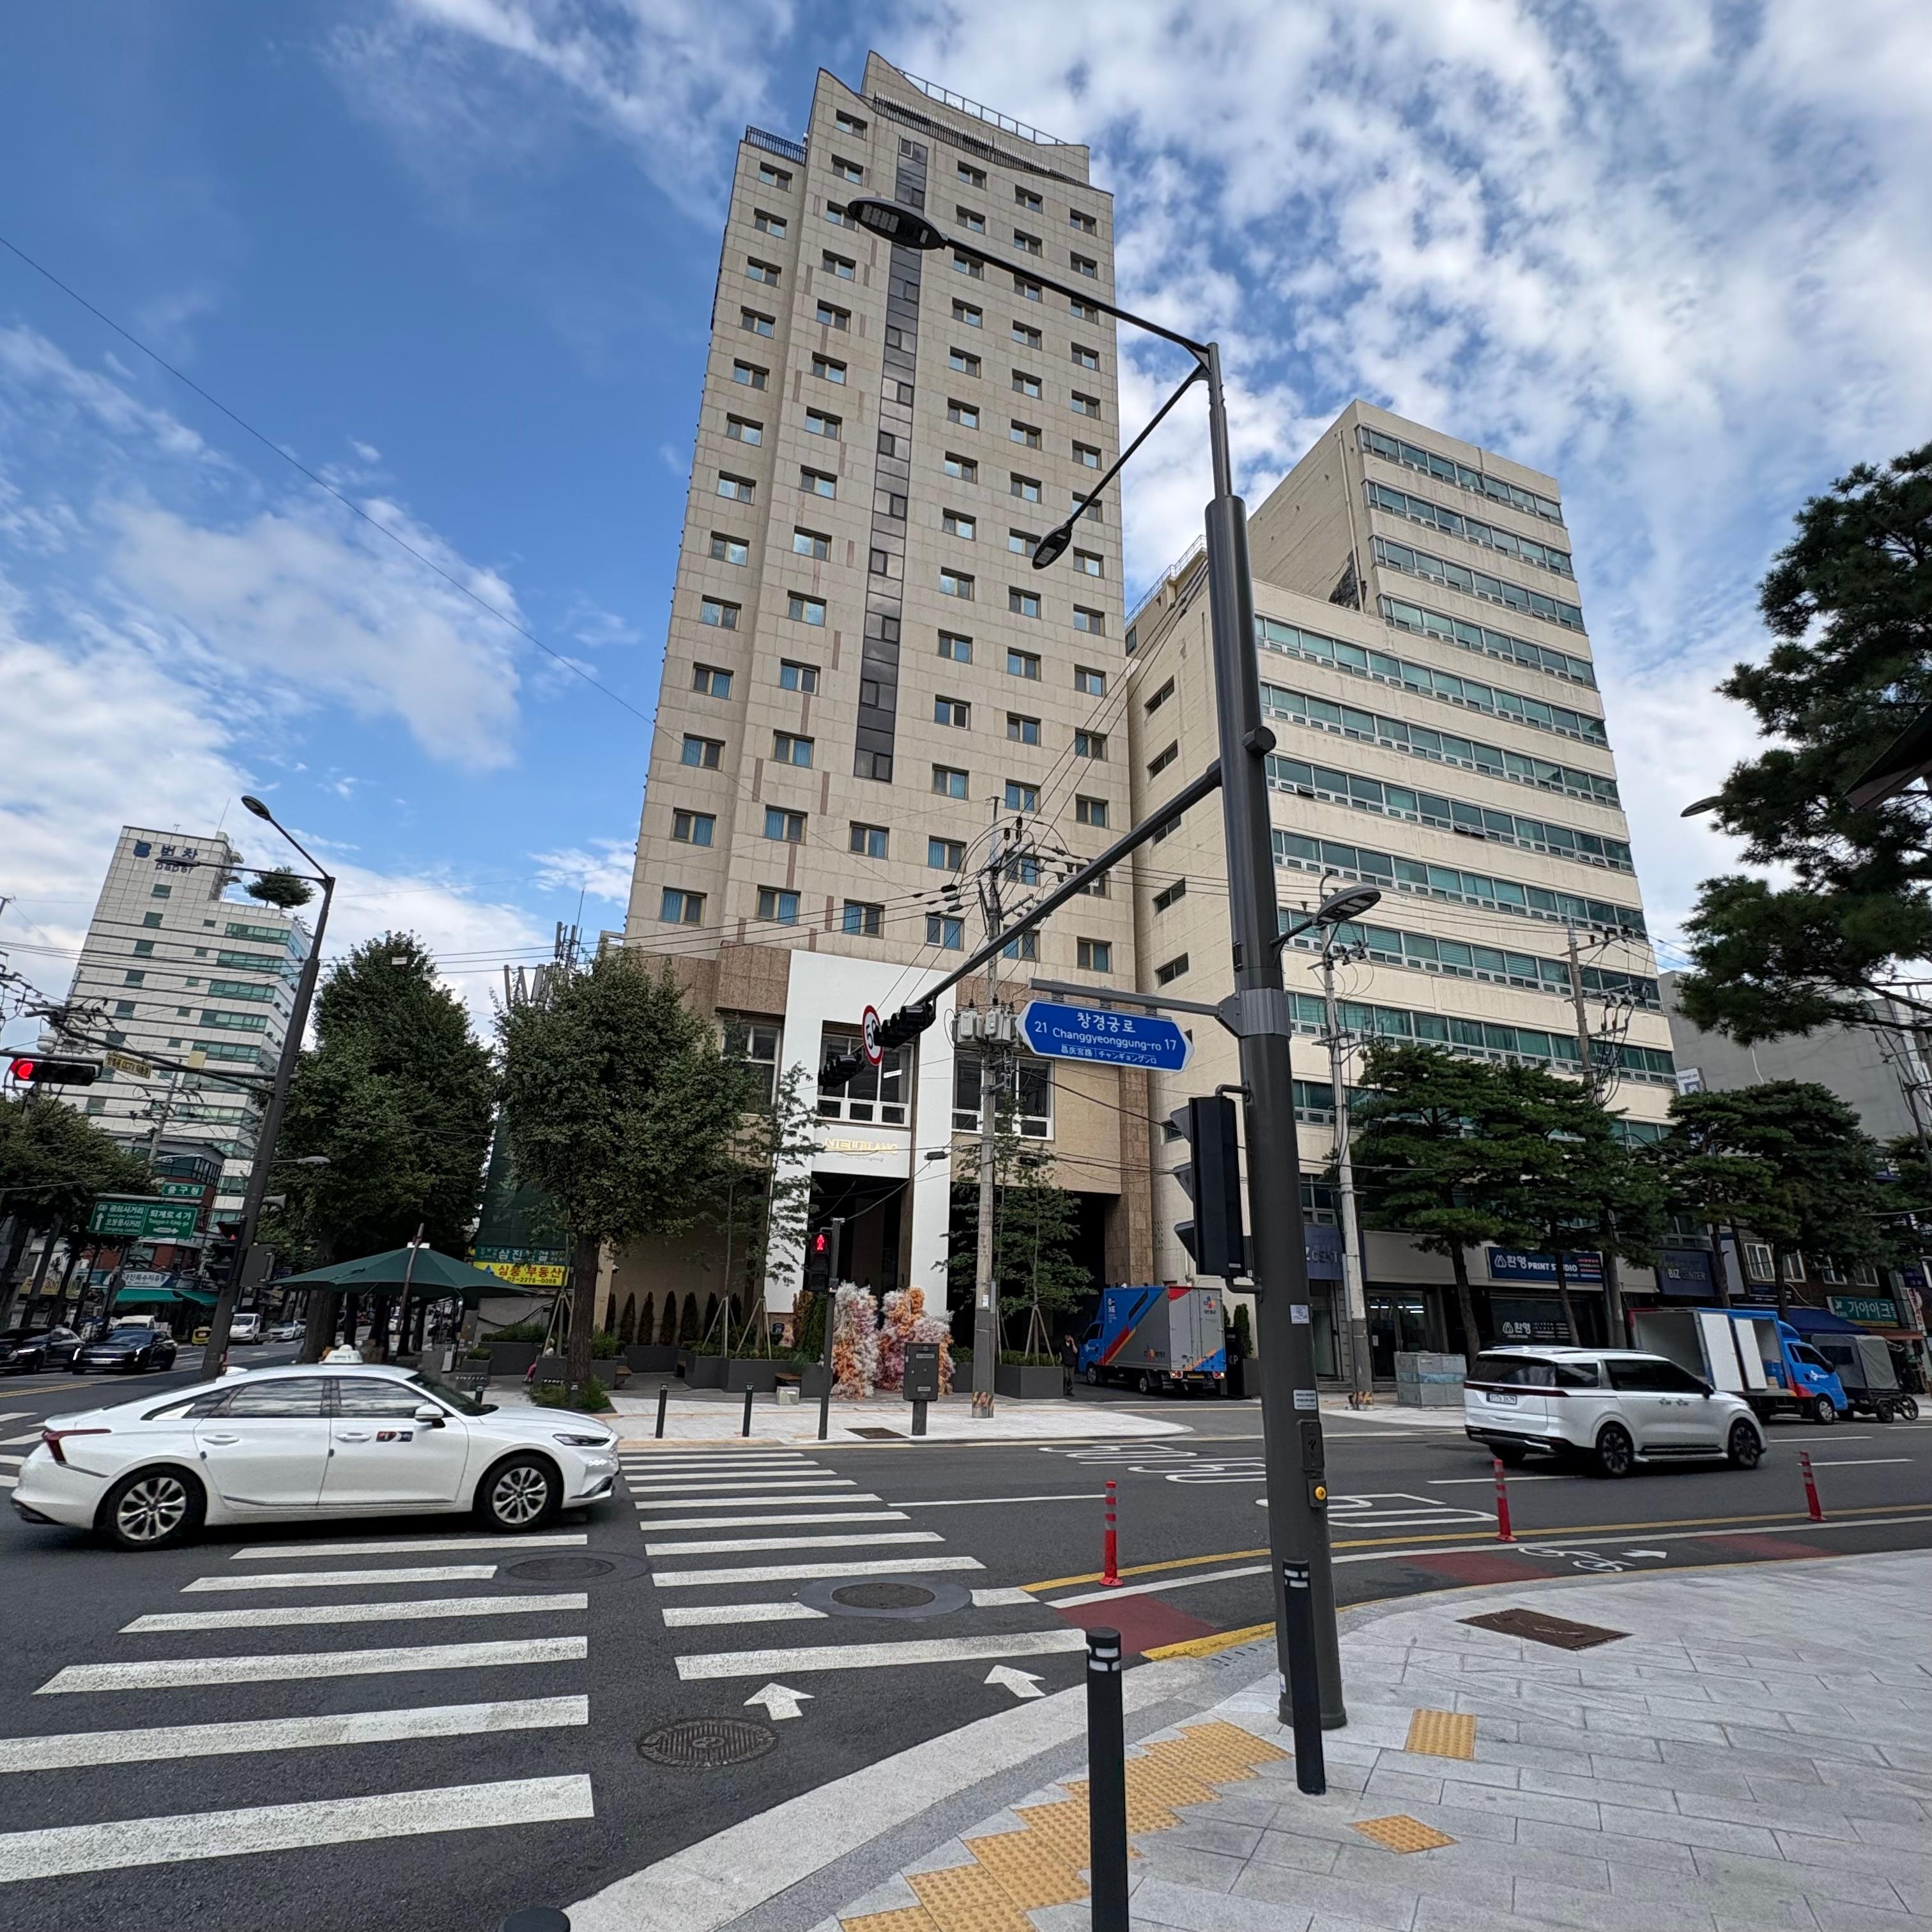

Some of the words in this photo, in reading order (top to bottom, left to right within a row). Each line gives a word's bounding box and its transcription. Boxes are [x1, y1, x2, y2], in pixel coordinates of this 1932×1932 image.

[1077, 1011, 1136, 1033] 창경궁로
[1034, 1021, 1047, 1033] 21
[1052, 1027, 1162, 1052] Changgyeonggung-ro
[1164, 1039, 1177, 1051] 17
[526, 1266, 563, 1278] 부동산
[1506, 1255, 1527, 1269] 환영
[1528, 1262, 1549, 1271] PRINT
[1551, 1264, 1578, 1272] SDIO
[1668, 1268, 1681, 1278] BIZ
